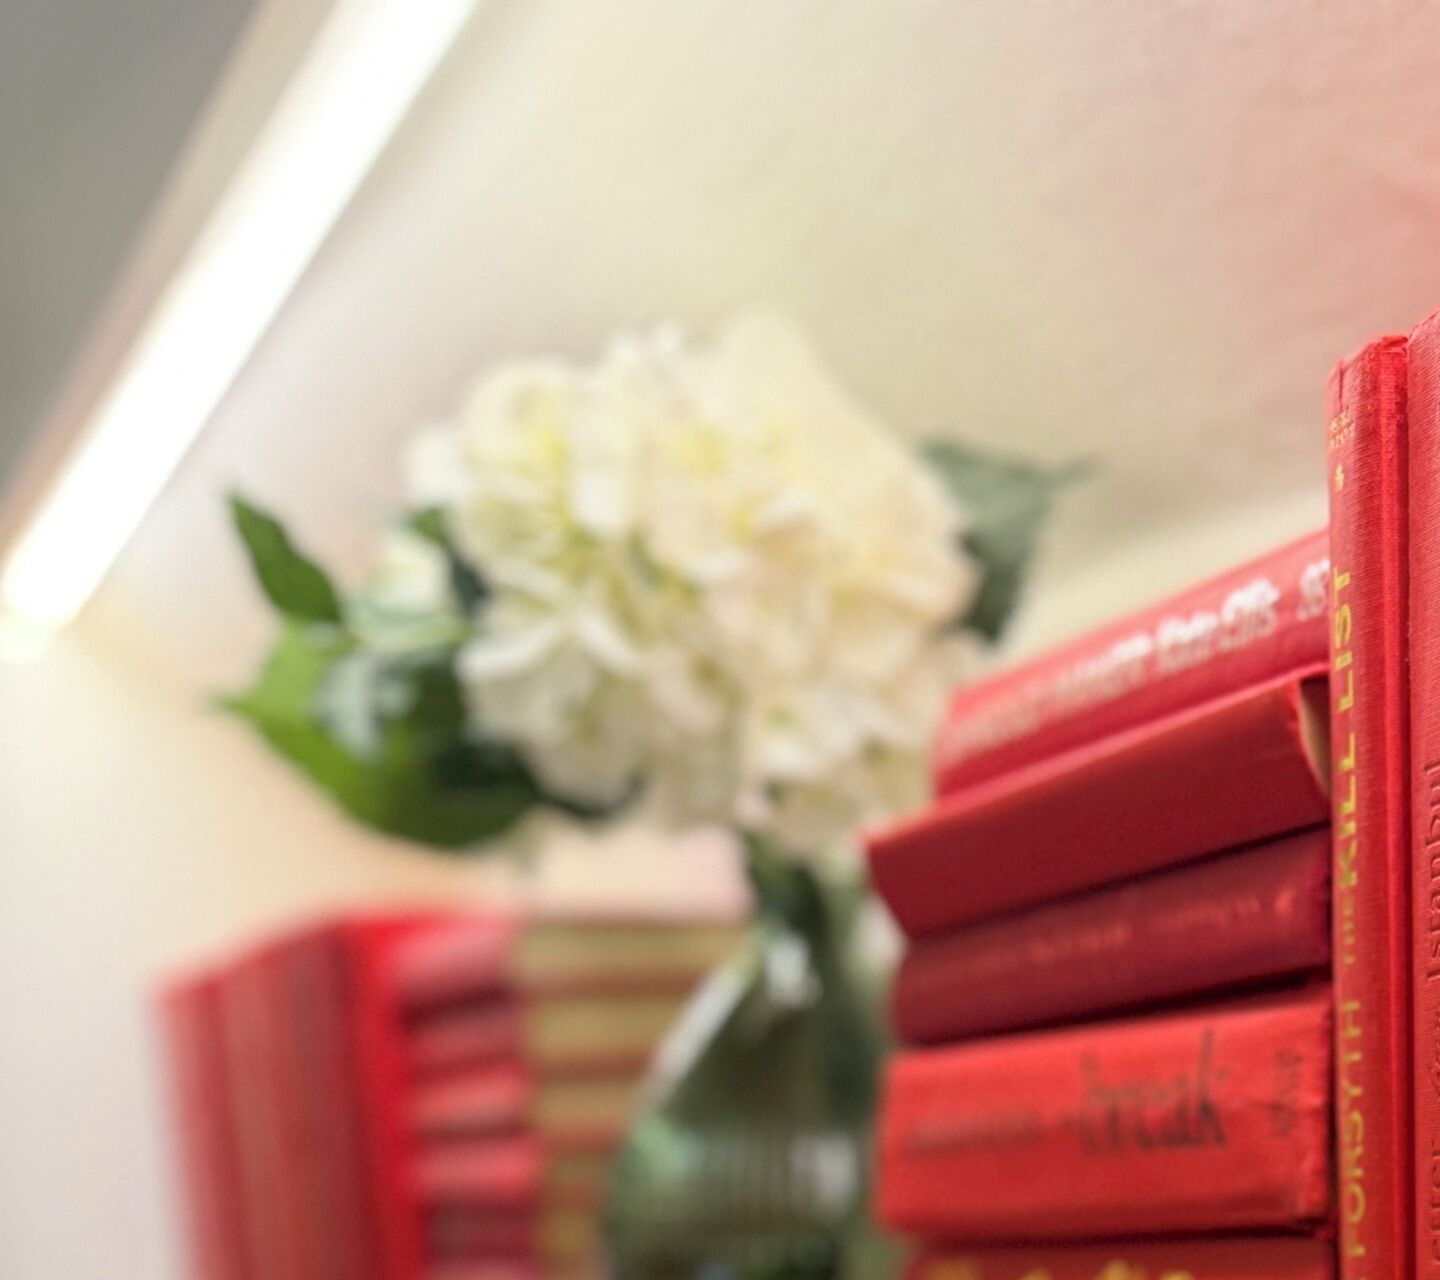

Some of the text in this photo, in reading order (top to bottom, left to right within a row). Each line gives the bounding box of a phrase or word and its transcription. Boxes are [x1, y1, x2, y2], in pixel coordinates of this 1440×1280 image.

[1332, 567, 1354, 713] LIST
[1338, 731, 1358, 888] KILL
[1338, 1000, 1366, 1257] FORSYTH
